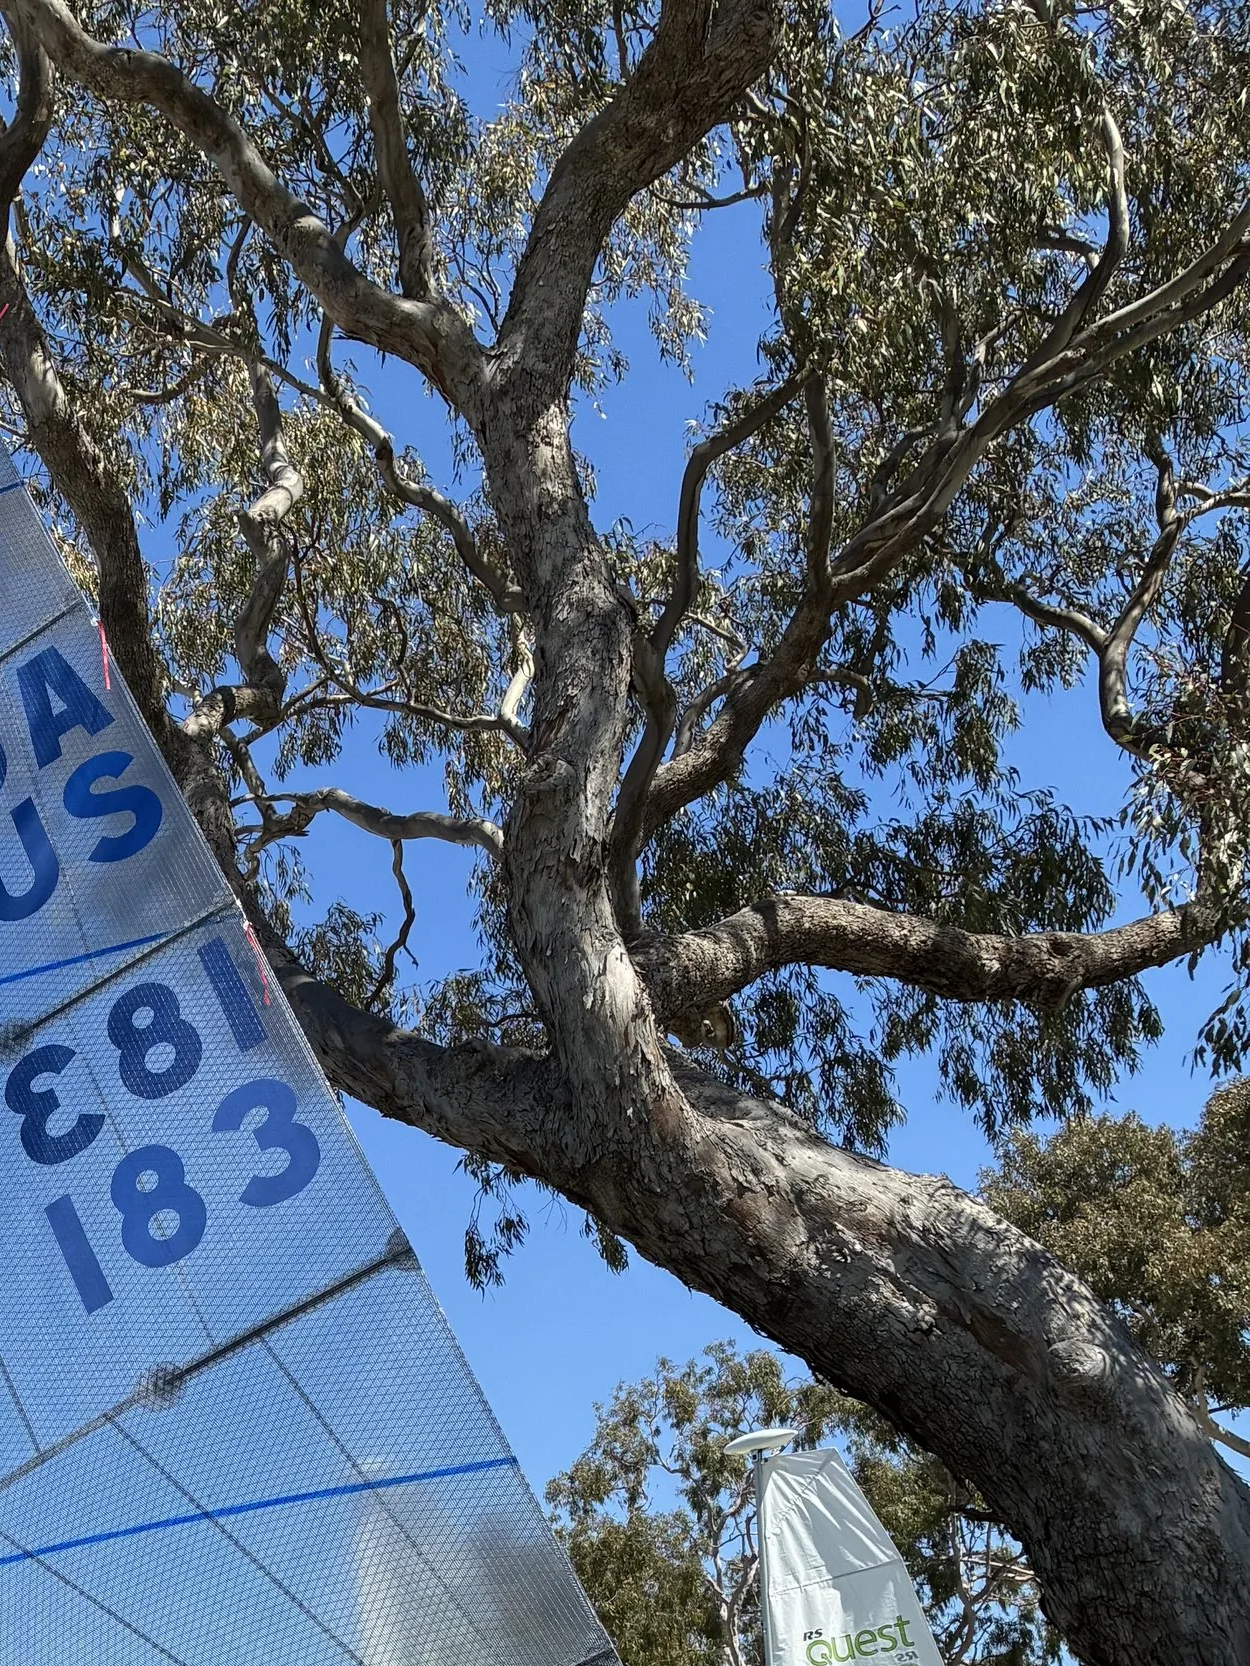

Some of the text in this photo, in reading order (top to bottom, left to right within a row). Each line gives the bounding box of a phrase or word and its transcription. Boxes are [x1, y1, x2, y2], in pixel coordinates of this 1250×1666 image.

[44, 1078, 321, 1316] 183
[803, 1628, 823, 1641] RS
[806, 1615, 915, 1666] Quest
